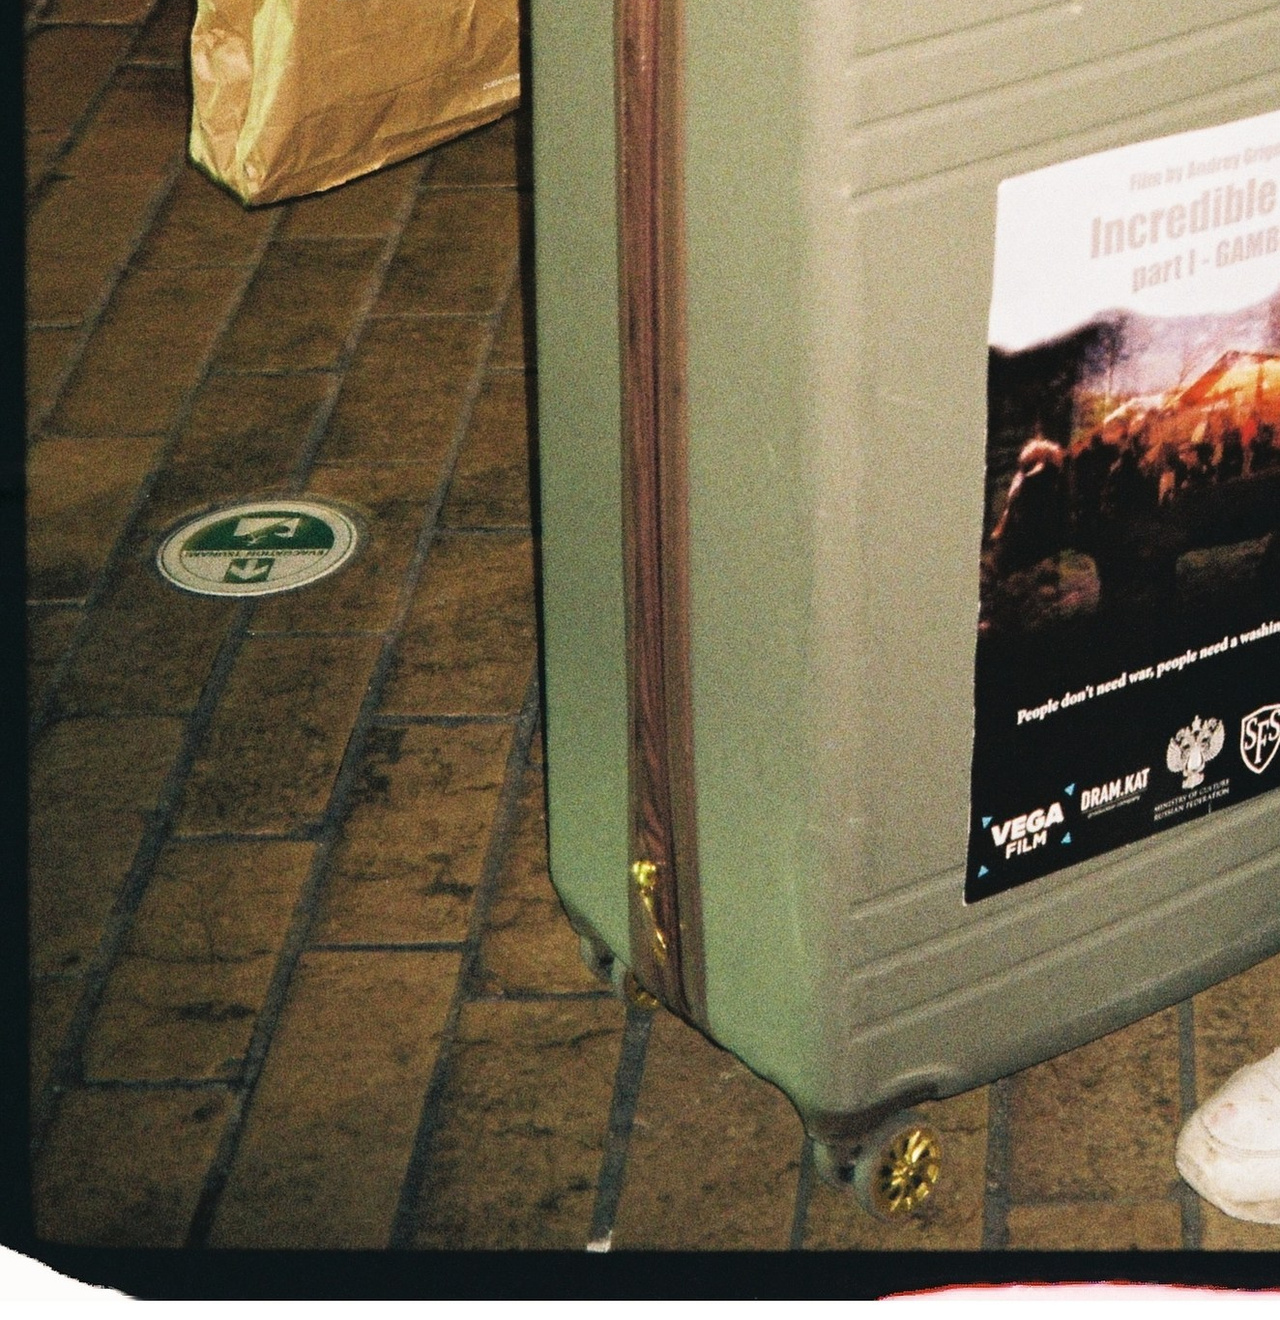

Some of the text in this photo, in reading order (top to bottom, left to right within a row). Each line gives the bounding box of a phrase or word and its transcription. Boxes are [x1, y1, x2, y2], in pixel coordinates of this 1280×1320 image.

[1130, 171, 1162, 191] Film
[1165, 166, 1183, 184] by
[1090, 177, 1277, 259] Incredible
[1131, 254, 1183, 294] part
[1017, 698, 1060, 726] People
[1060, 684, 1095, 708] don't
[1096, 672, 1128, 696] need
[1128, 666, 1155, 685] war,
[1156, 649, 1198, 679] people
[1199, 635, 1229, 660] need
[1230, 636, 1239, 649] a
[1080, 767, 1151, 812] DRAM.KAT
[990, 801, 1065, 847] VEGA
[1005, 830, 1047, 860] FILM
